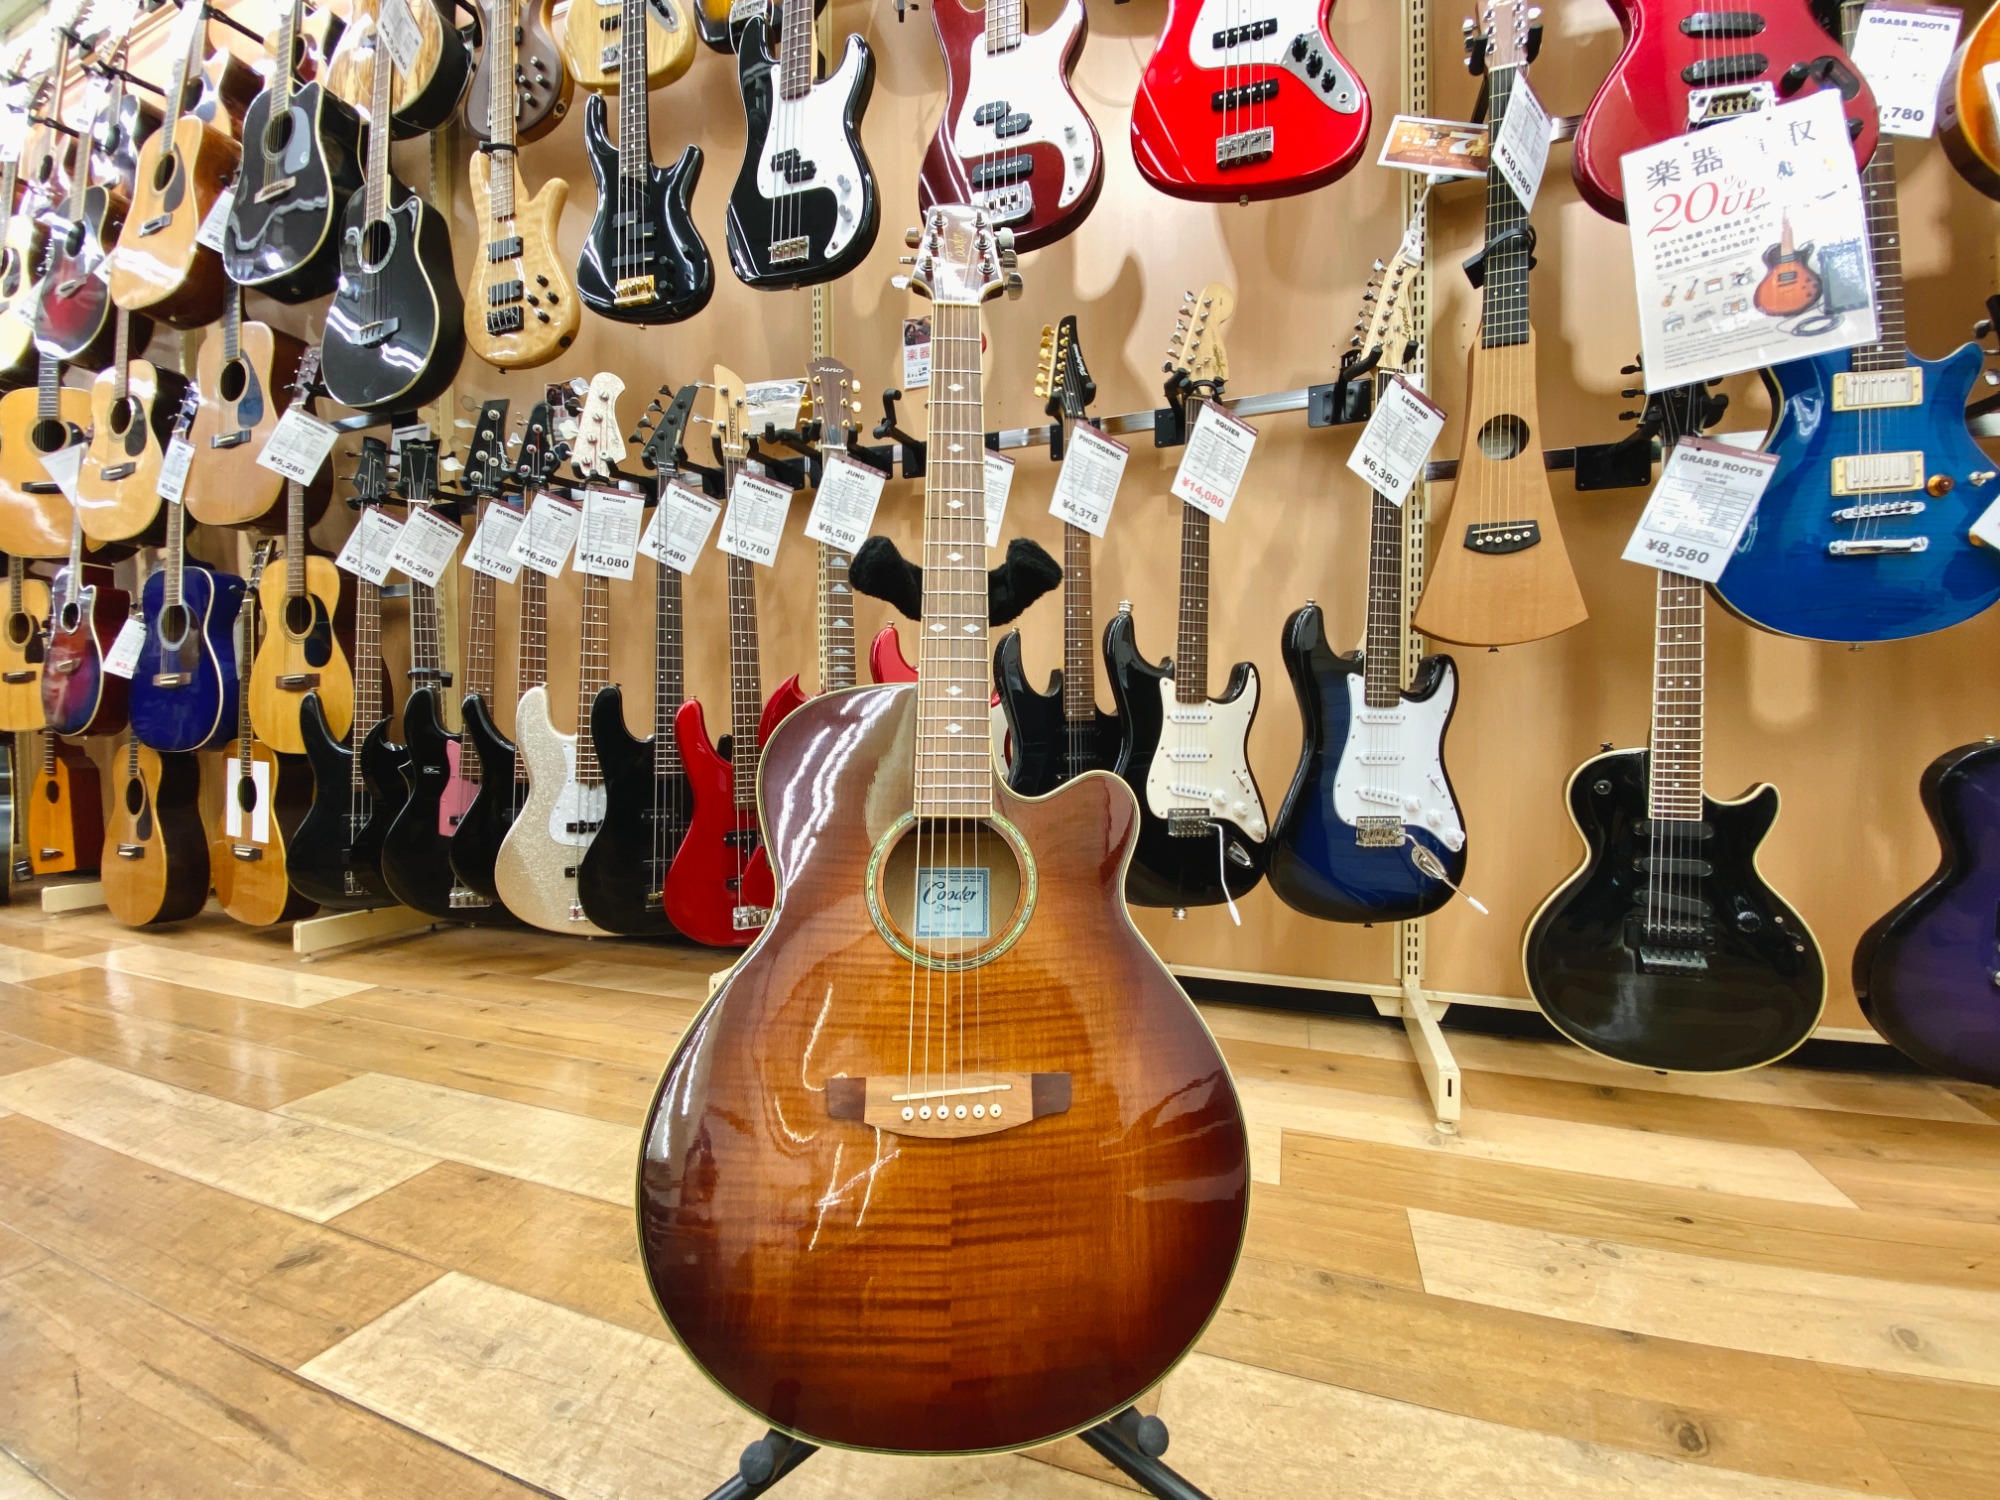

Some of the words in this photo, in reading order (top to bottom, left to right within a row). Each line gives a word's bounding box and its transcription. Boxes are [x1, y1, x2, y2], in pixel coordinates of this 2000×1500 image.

[1869, 16, 1908, 27] GRASS
[1911, 20, 1950, 31] ROOTS
[1500, 145, 1532, 196] ¥30,580
[1401, 395, 1428, 420] LEGEND
[295, 416, 328, 435] STAFFORD
[1215, 418, 1240, 438] SQUIER
[1078, 433, 1121, 460] PHOTOGENIC
[270, 454, 305, 475] ¥5,280
[845, 469, 866, 481] JUNO
[1362, 454, 1399, 489] ¥6,380
[1680, 453, 1720, 468] GRASS
[1722, 462, 1764, 477] ROOTS
[603, 496, 626, 504] BACCHUS
[672, 490, 712, 513] FERNANDES
[742, 480, 784, 500] FERNANDES
[1182, 477, 1224, 508] ¥14,080
[496, 508, 525, 524] RIVERHE
[1062, 499, 1099, 523] ¥4,378
[377, 517, 399, 530] IBANEZ
[417, 511, 438, 526] GRASS
[438, 523, 459, 538] ROOTS
[818, 522, 856, 543] ¥8,580
[517, 545, 558, 568] ¥16,280
[651, 540, 687, 563] ¥7,480
[726, 534, 770, 556] ¥10,780
[1646, 538, 1709, 564] ¥8,580
[345, 553, 381, 577] ¥21,780
[394, 553, 434, 579] ¥16,280
[472, 553, 512, 575] ¥21,780
[580, 552, 630, 569] ¥14,080
[923, 881, 978, 905] Cooder
